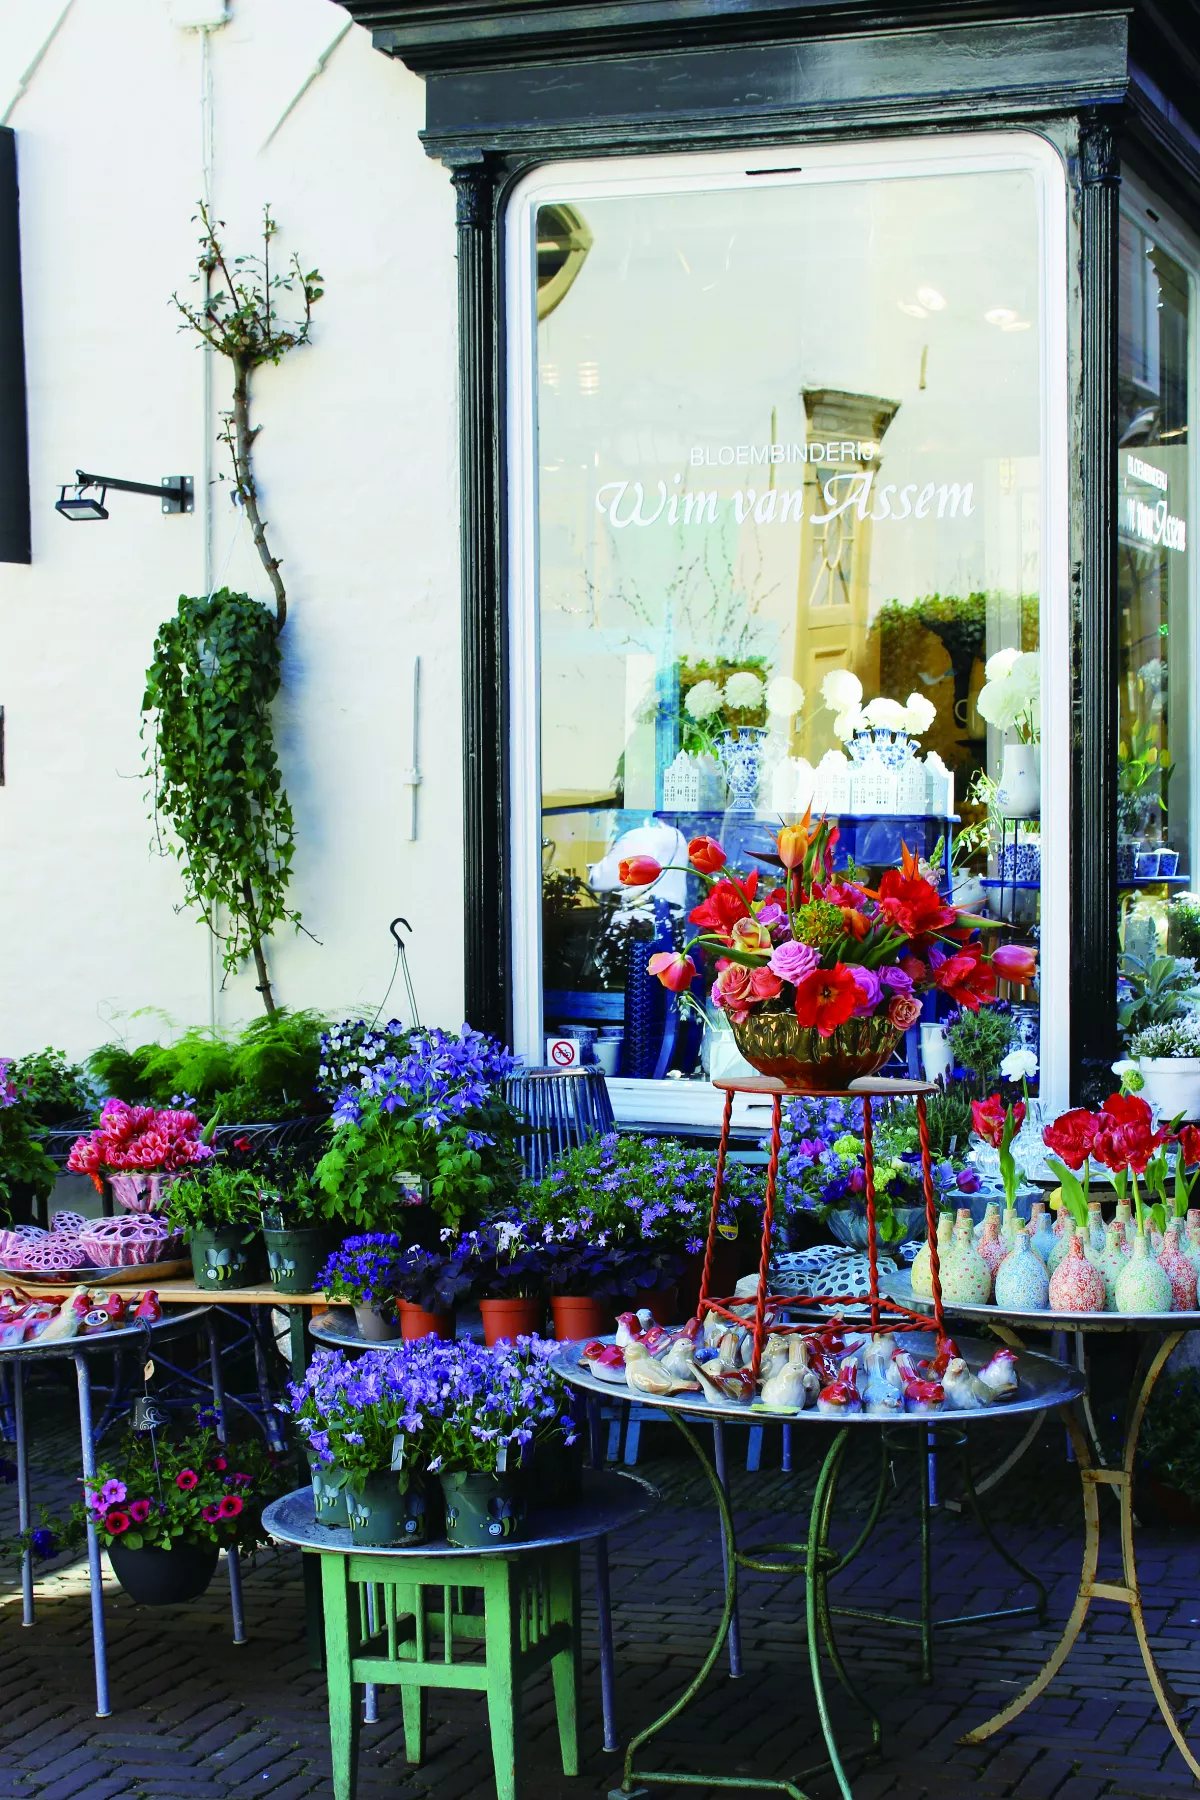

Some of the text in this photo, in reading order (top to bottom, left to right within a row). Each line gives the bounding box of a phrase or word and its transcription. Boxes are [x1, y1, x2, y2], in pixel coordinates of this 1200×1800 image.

[690, 441, 874, 467] BLOEMBINDERIJ
[595, 471, 977, 529] Wim van Assem
